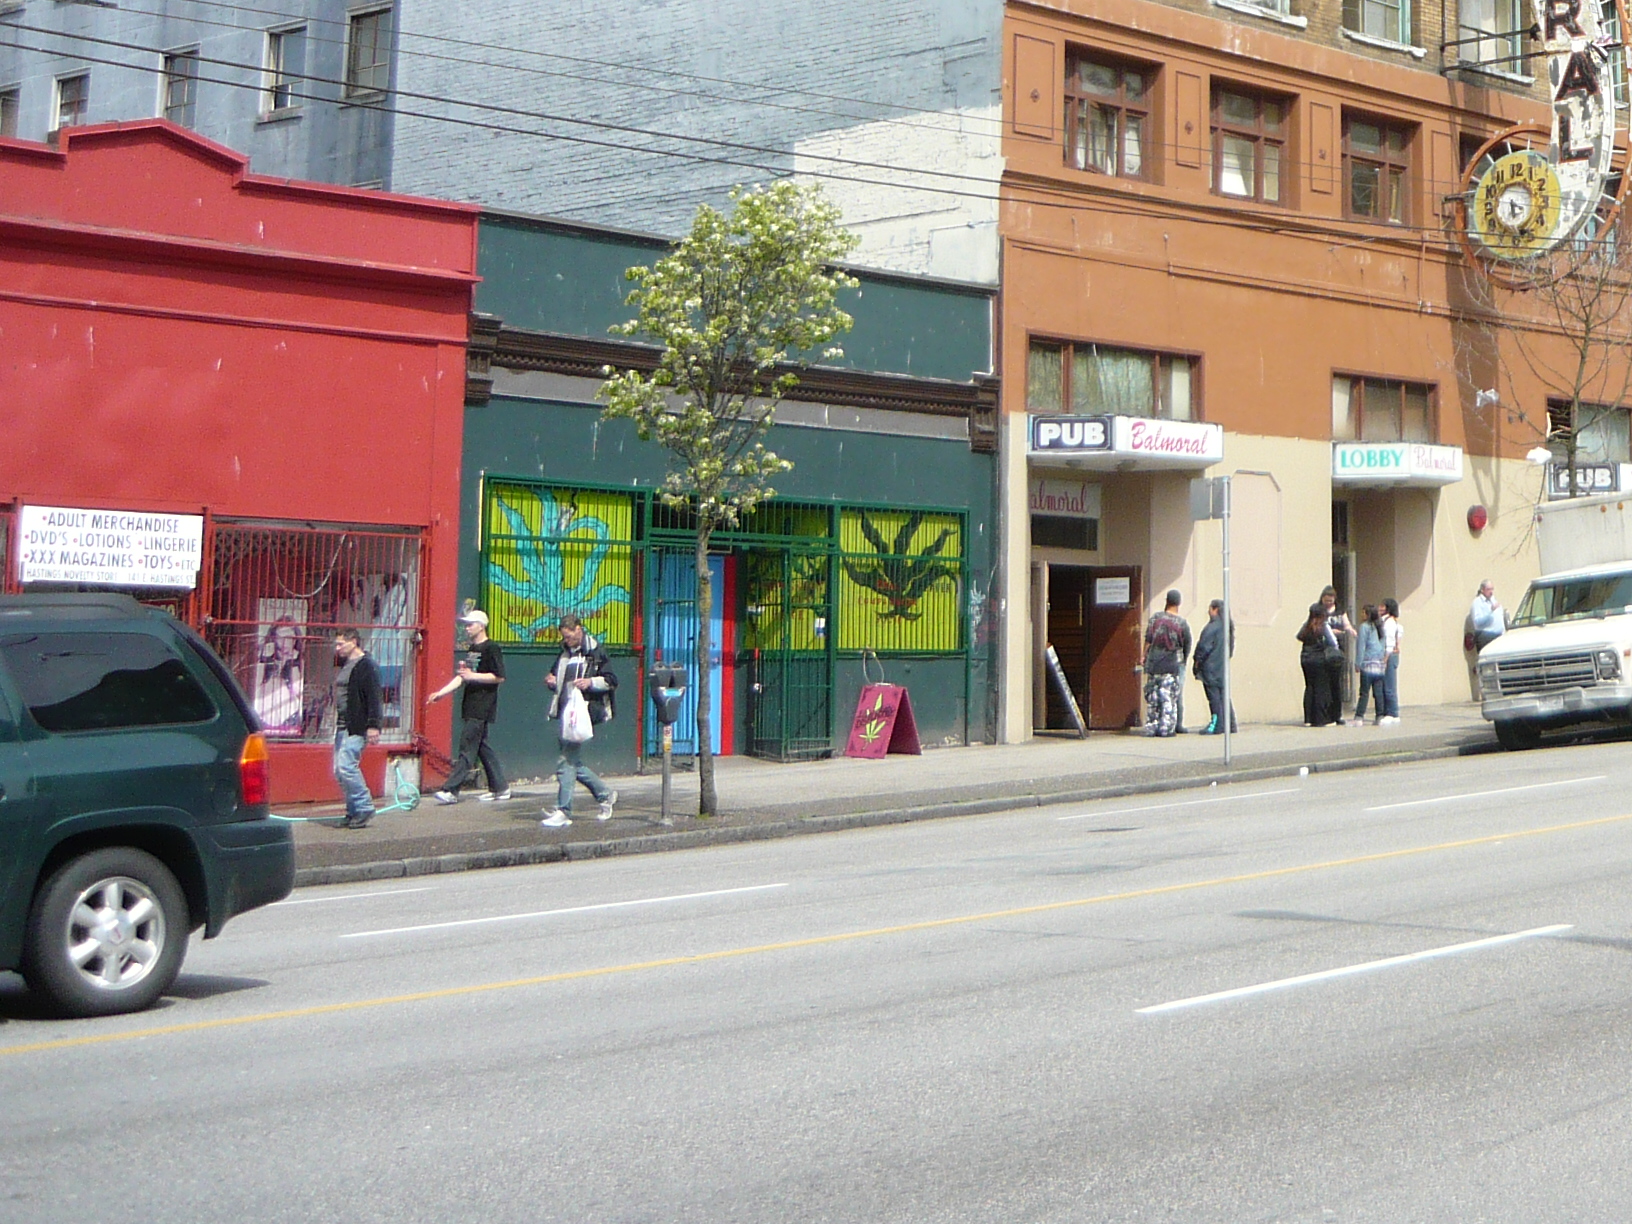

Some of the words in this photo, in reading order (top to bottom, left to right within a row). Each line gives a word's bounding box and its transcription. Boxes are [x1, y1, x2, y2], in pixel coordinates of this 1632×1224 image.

[1040, 422, 1106, 447] PUB
[1131, 421, 1209, 455] Balmoral
[1341, 449, 1404, 468] LOBBY
[1414, 446, 1456, 471] Balmoral
[1030, 480, 1088, 514] almoral
[48, 512, 87, 528] ADULT
[91, 514, 179, 534] MERCHANDISE
[30, 530, 68, 545] DVD'S
[79, 533, 132, 549] LOTIONS
[144, 536, 197, 553] LINGERIE
[29, 549, 56, 565] XXX
[59, 551, 134, 568] MAGAZINES
[143, 555, 173, 570] TOYS
[26, 569, 61, 579] HASTINGS
[151, 573, 184, 584] HASTINGS
